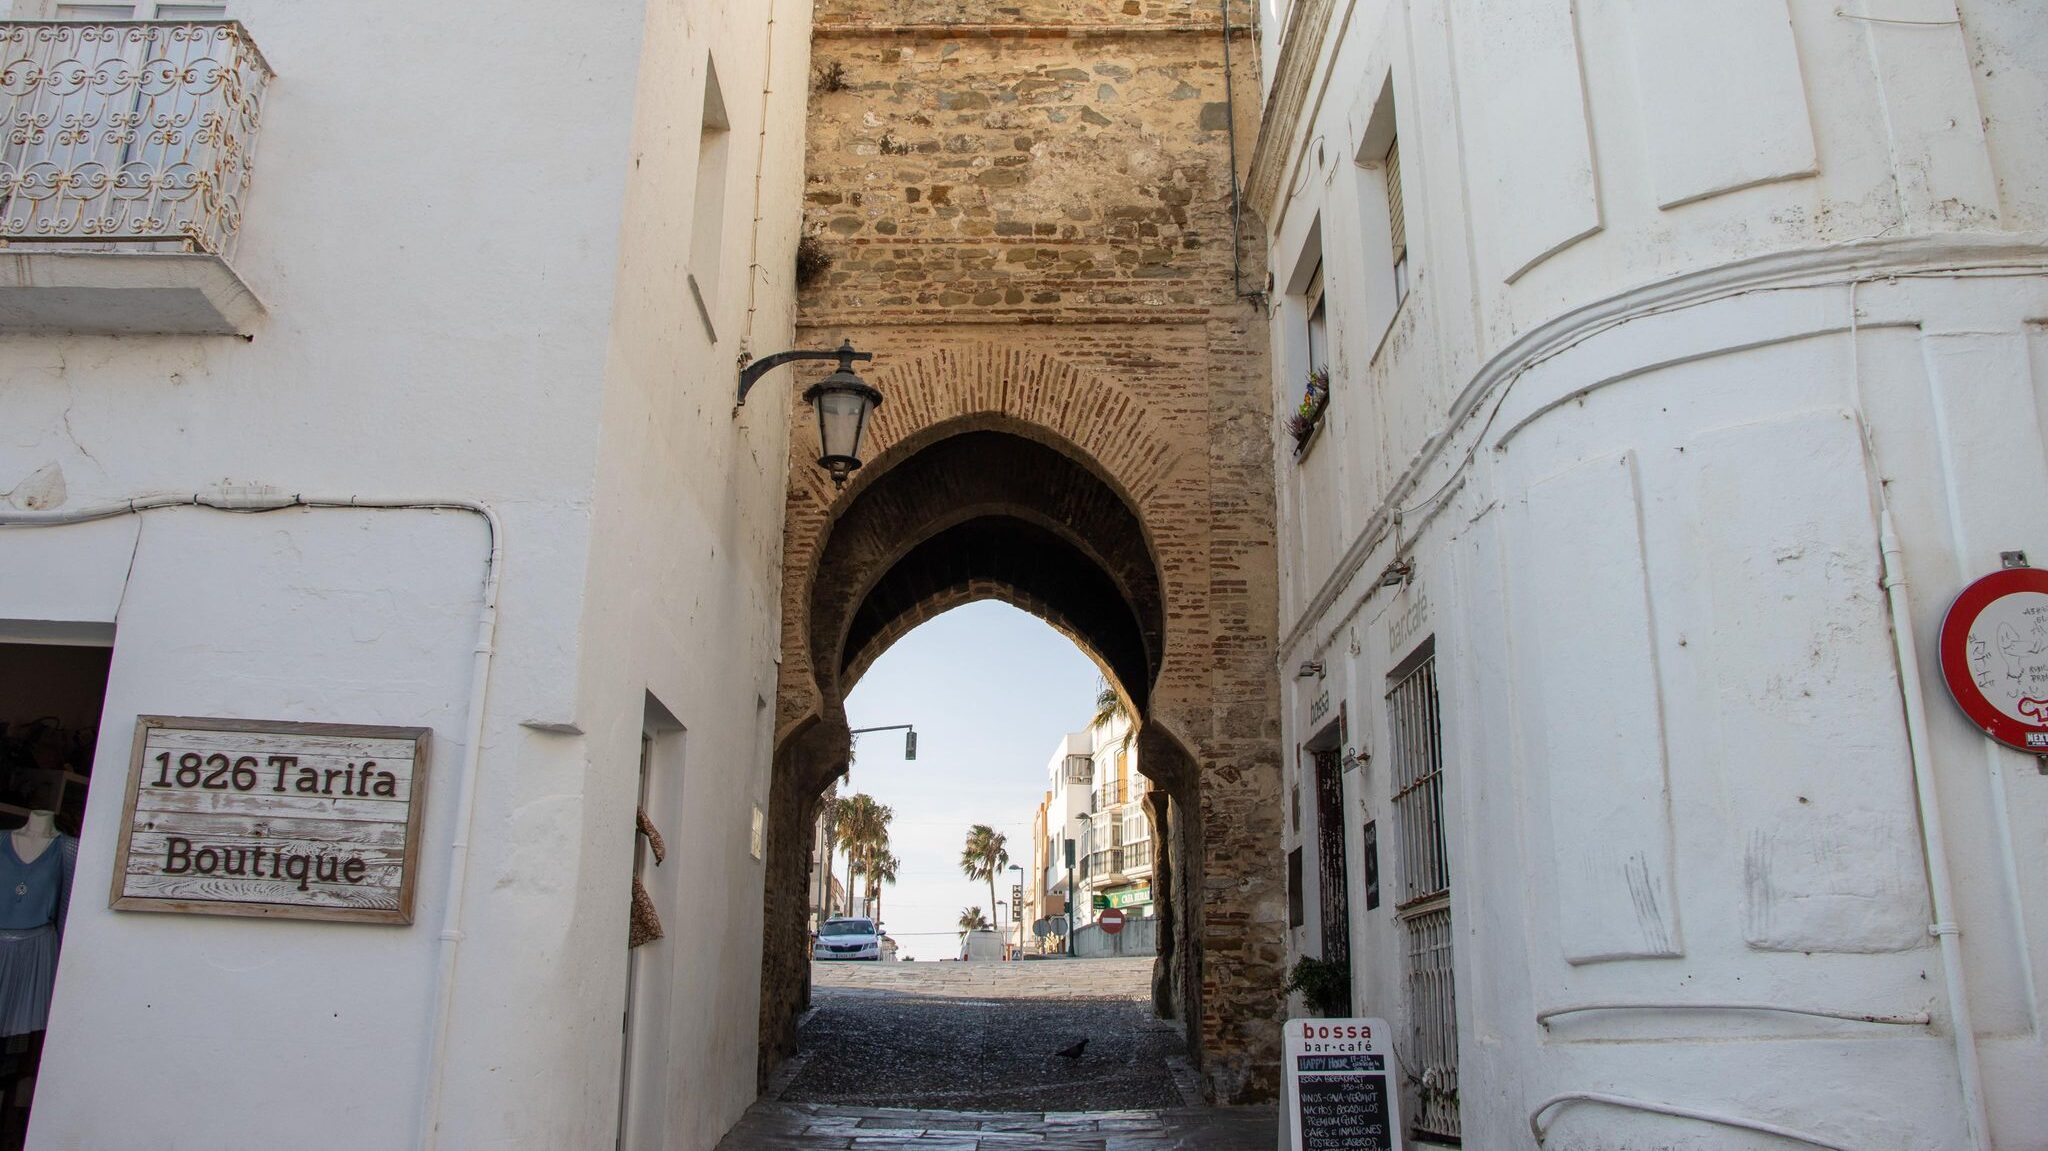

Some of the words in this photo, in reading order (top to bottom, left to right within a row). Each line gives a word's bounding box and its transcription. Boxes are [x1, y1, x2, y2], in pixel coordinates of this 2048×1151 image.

[1310, 689, 1329, 727] bossa
[151, 751, 259, 791] 1826
[268, 755, 397, 797] Tarifa
[162, 837, 366, 891] Boutique
[1303, 1023, 1372, 1039] bossa
[1299, 1058, 1326, 1070] HAPPY
